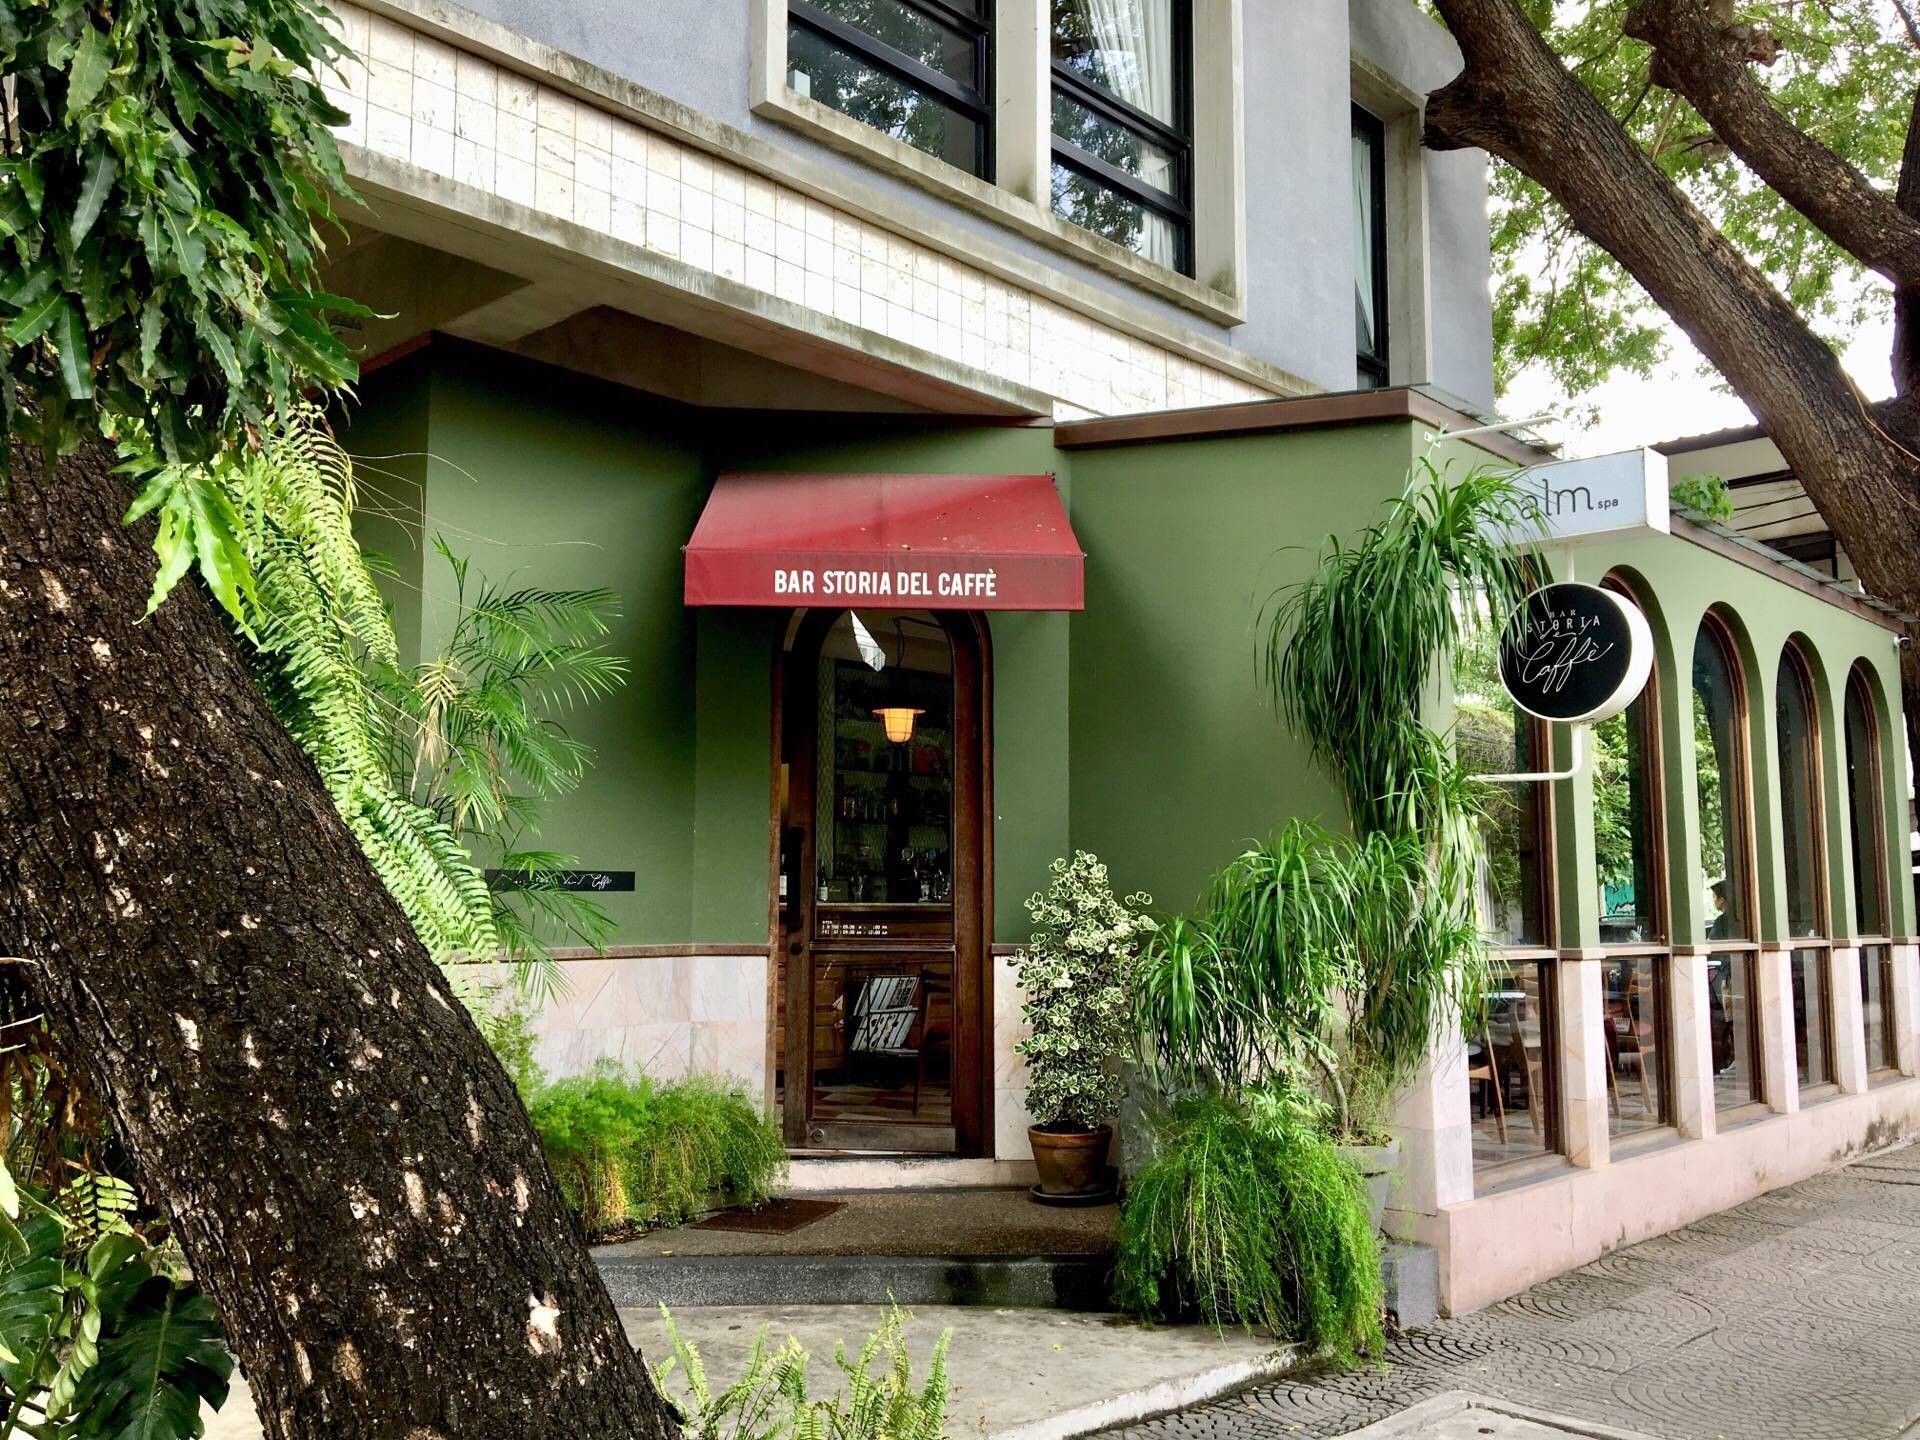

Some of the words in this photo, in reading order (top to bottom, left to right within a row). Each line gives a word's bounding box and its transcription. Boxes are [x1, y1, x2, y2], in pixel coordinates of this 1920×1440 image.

[1597, 498, 1619, 514] spa
[774, 569, 815, 593] BAR
[822, 571, 892, 596] STORIA
[897, 571, 933, 596] DEL
[938, 568, 997, 597] CAFFÈ
[1549, 609, 1576, 618] BAR
[1526, 615, 1601, 634] STORIA
[1516, 637, 1615, 694] Caffè
